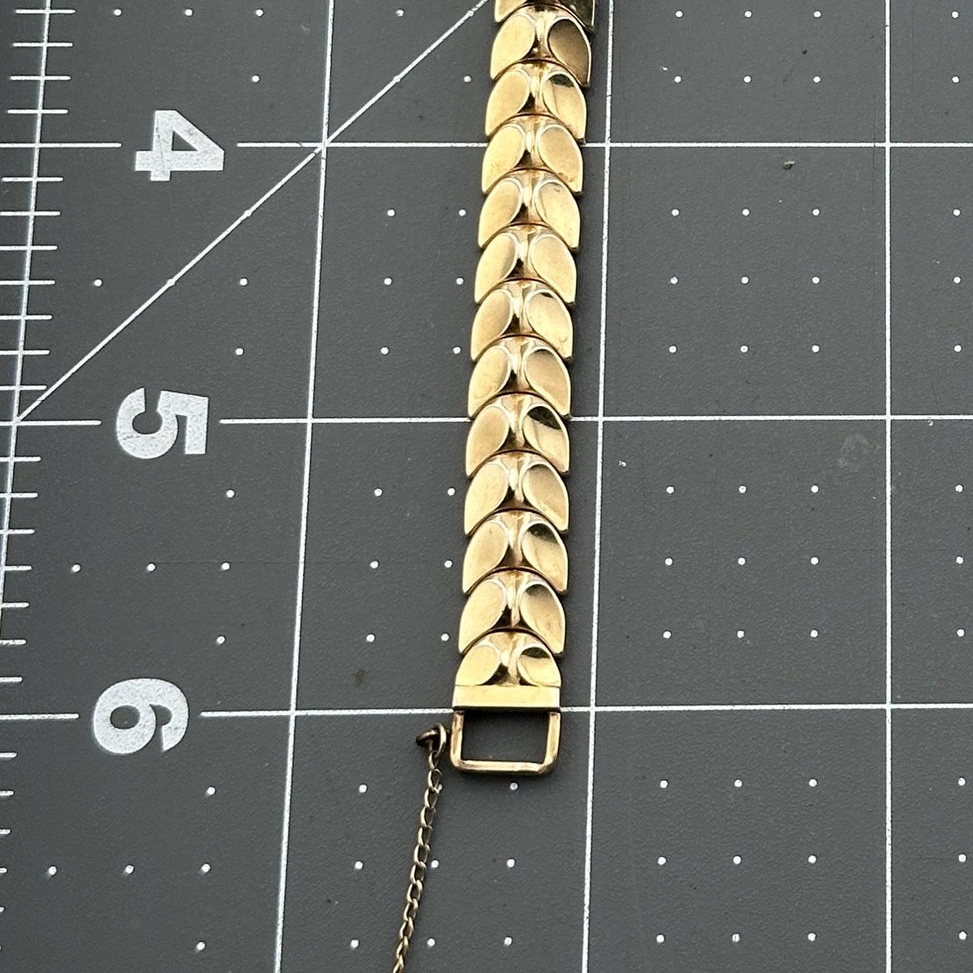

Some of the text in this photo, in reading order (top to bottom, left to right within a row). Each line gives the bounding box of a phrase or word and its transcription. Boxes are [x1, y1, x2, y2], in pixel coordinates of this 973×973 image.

[134, 110, 224, 181] 4
[116, 387, 209, 459] 5
[92, 678, 189, 754] 6
